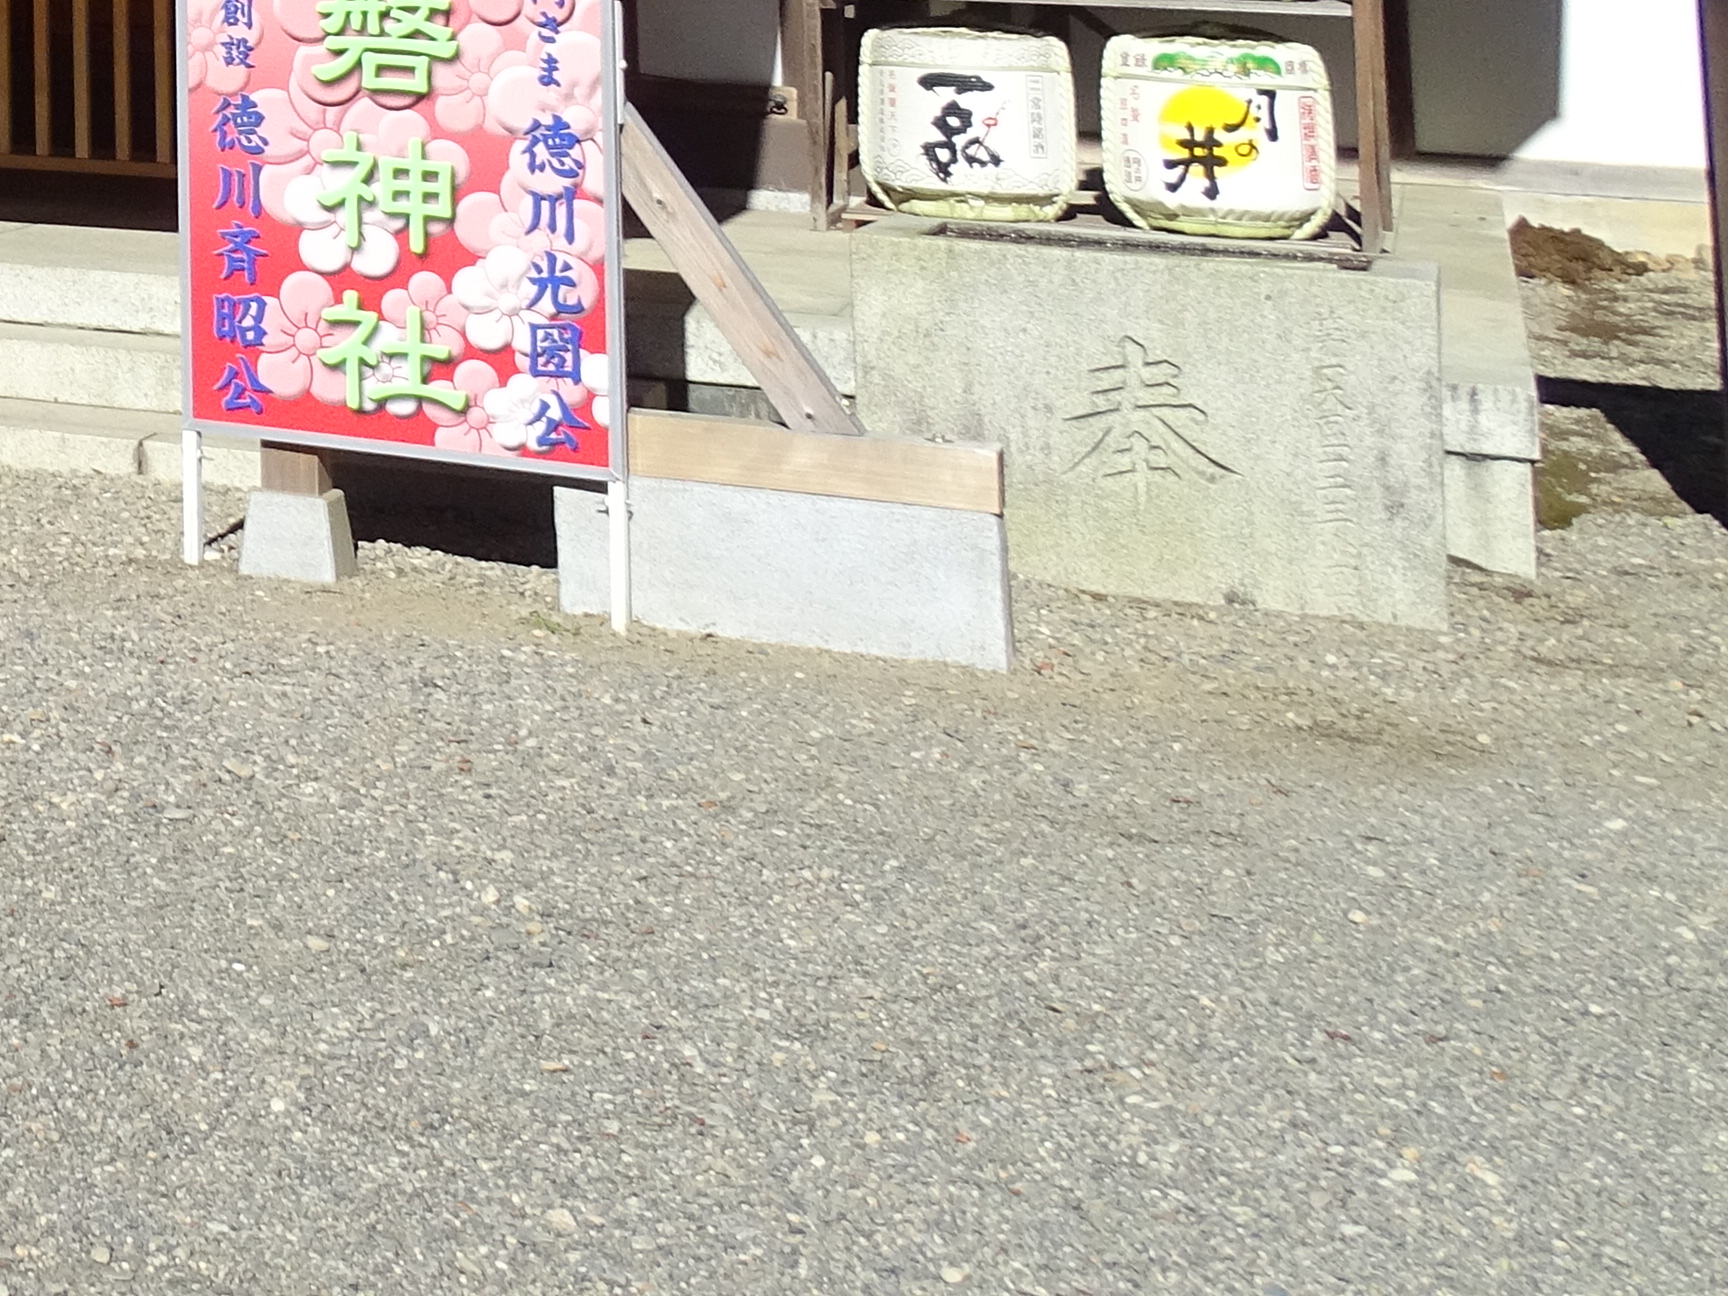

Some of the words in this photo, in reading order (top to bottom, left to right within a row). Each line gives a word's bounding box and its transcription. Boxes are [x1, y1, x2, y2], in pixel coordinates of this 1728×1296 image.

[210, 93, 273, 418] 徳川斉昭公
[1161, 88, 1279, 202] 月の井
[519, 111, 592, 456] 徳川光圀公
[1060, 334, 1245, 511] 奉
